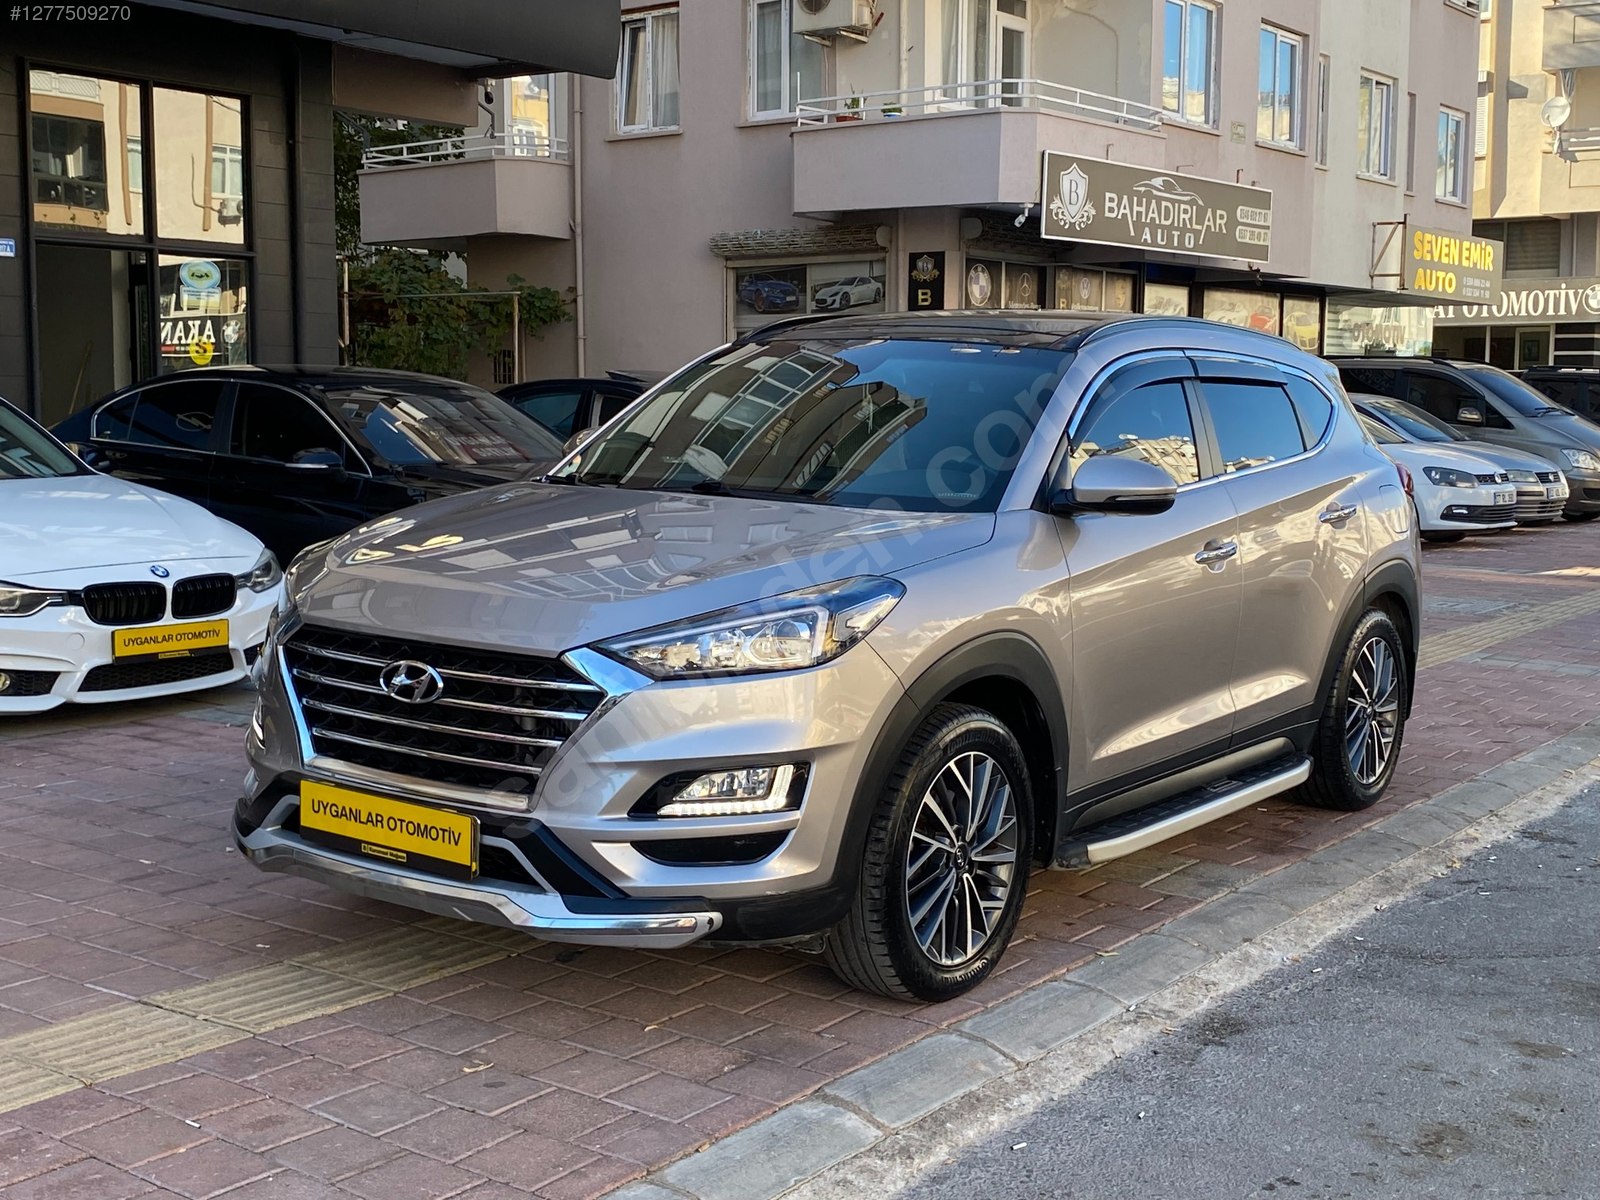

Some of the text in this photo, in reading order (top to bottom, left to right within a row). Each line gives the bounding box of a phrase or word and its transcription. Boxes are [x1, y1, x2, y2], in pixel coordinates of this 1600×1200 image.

[1069, 179, 1079, 205] B
[1104, 191, 1227, 244] BAHADIRLAR
[1141, 226, 1194, 248] AUTO
[1413, 230, 1494, 272] SEVEN EMİR
[1414, 267, 1456, 294] AUTO
[918, 289, 931, 305] B
[123, 628, 221, 647] UYGANLAR OTOMOTİV
[311, 798, 462, 847] UYGANLAR OTOMOTİV
